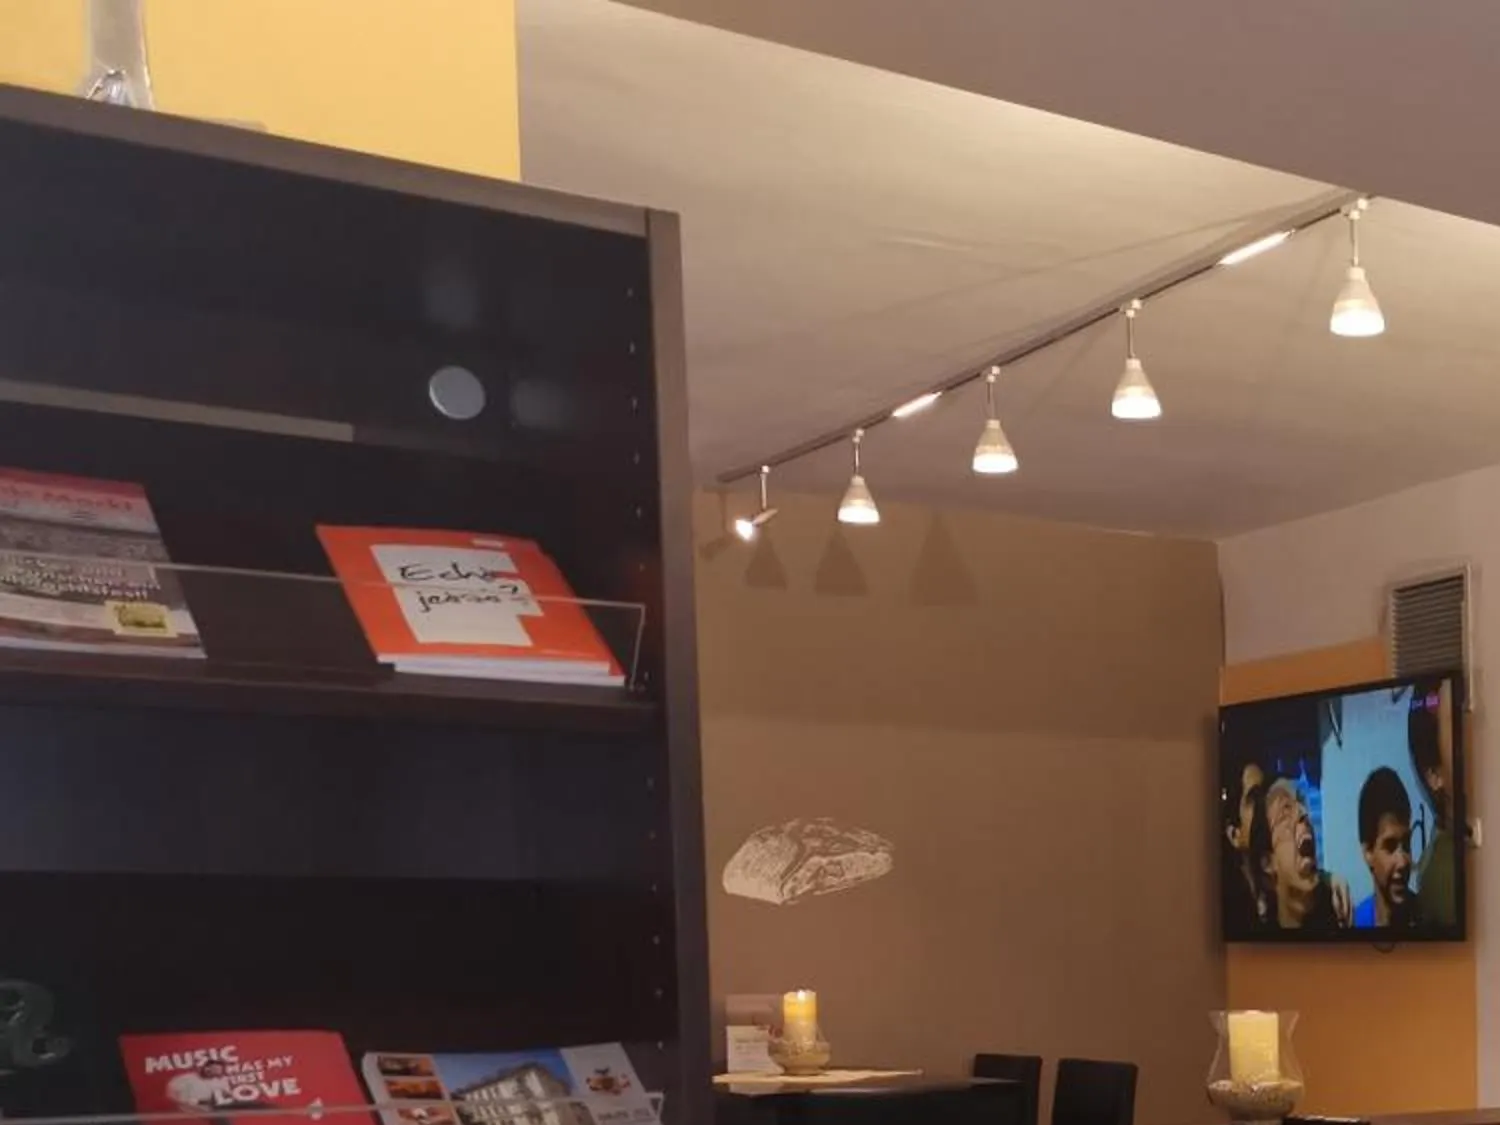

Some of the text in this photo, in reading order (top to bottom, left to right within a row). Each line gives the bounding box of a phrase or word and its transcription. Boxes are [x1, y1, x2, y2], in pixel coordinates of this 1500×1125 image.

[144, 1045, 239, 1074] MUSIC
[266, 1055, 294, 1070] MY
[214, 1076, 302, 1106] LOVE
